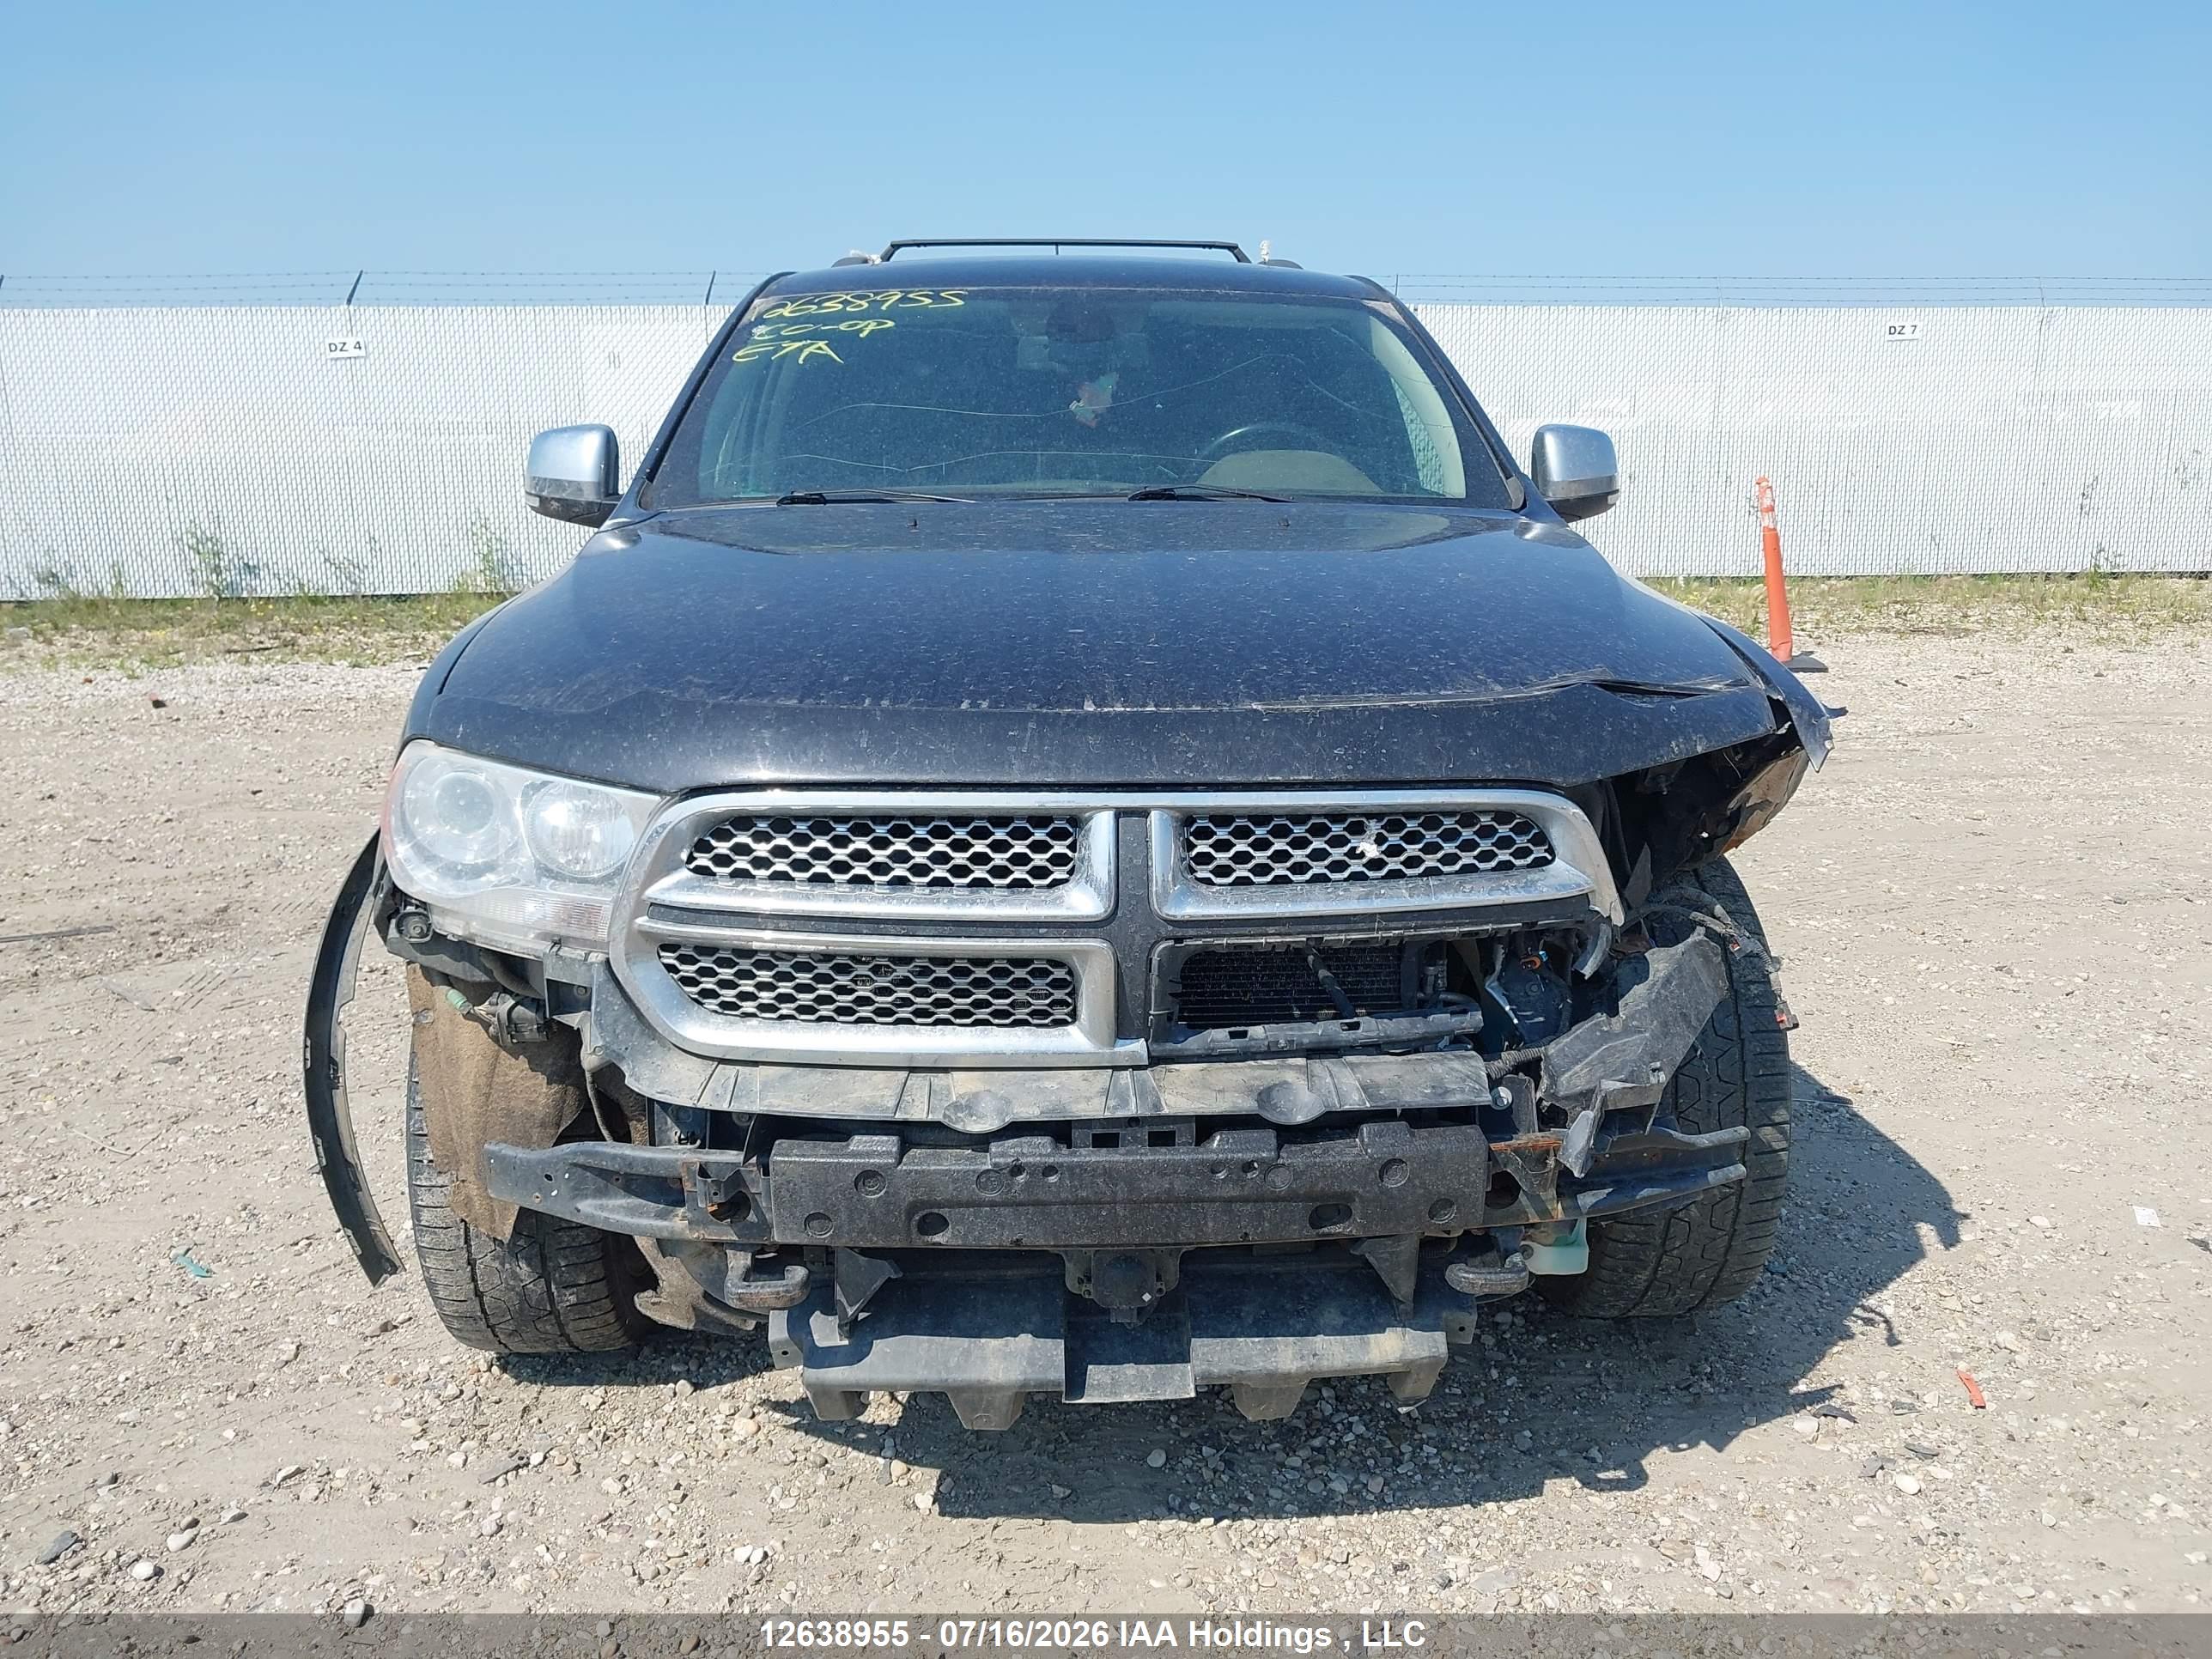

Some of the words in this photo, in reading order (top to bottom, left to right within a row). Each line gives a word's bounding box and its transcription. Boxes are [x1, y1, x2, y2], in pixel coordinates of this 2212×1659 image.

[750, 290, 969, 322] 12638955
[1888, 325, 1905, 335] DZ
[1910, 325, 1918, 335] 7
[328, 342, 349, 353] DZ
[353, 341, 362, 351] 4
